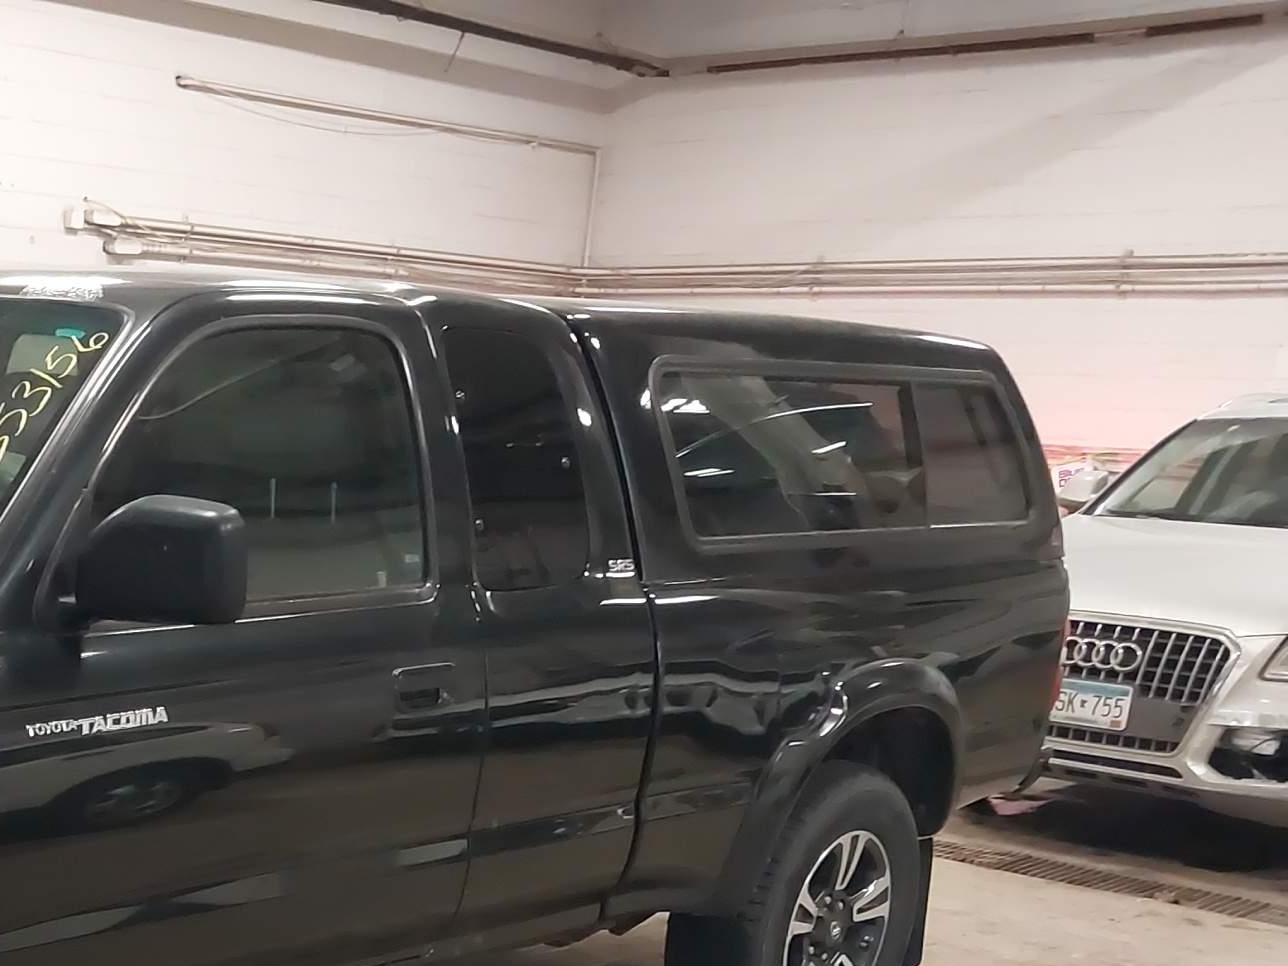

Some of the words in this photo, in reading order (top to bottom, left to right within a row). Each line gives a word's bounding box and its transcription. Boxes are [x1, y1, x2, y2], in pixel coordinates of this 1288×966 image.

[1091, 695, 1126, 718] 755
[26, 719, 78, 737] TOYOTA
[79, 706, 168, 735] TACOMA
